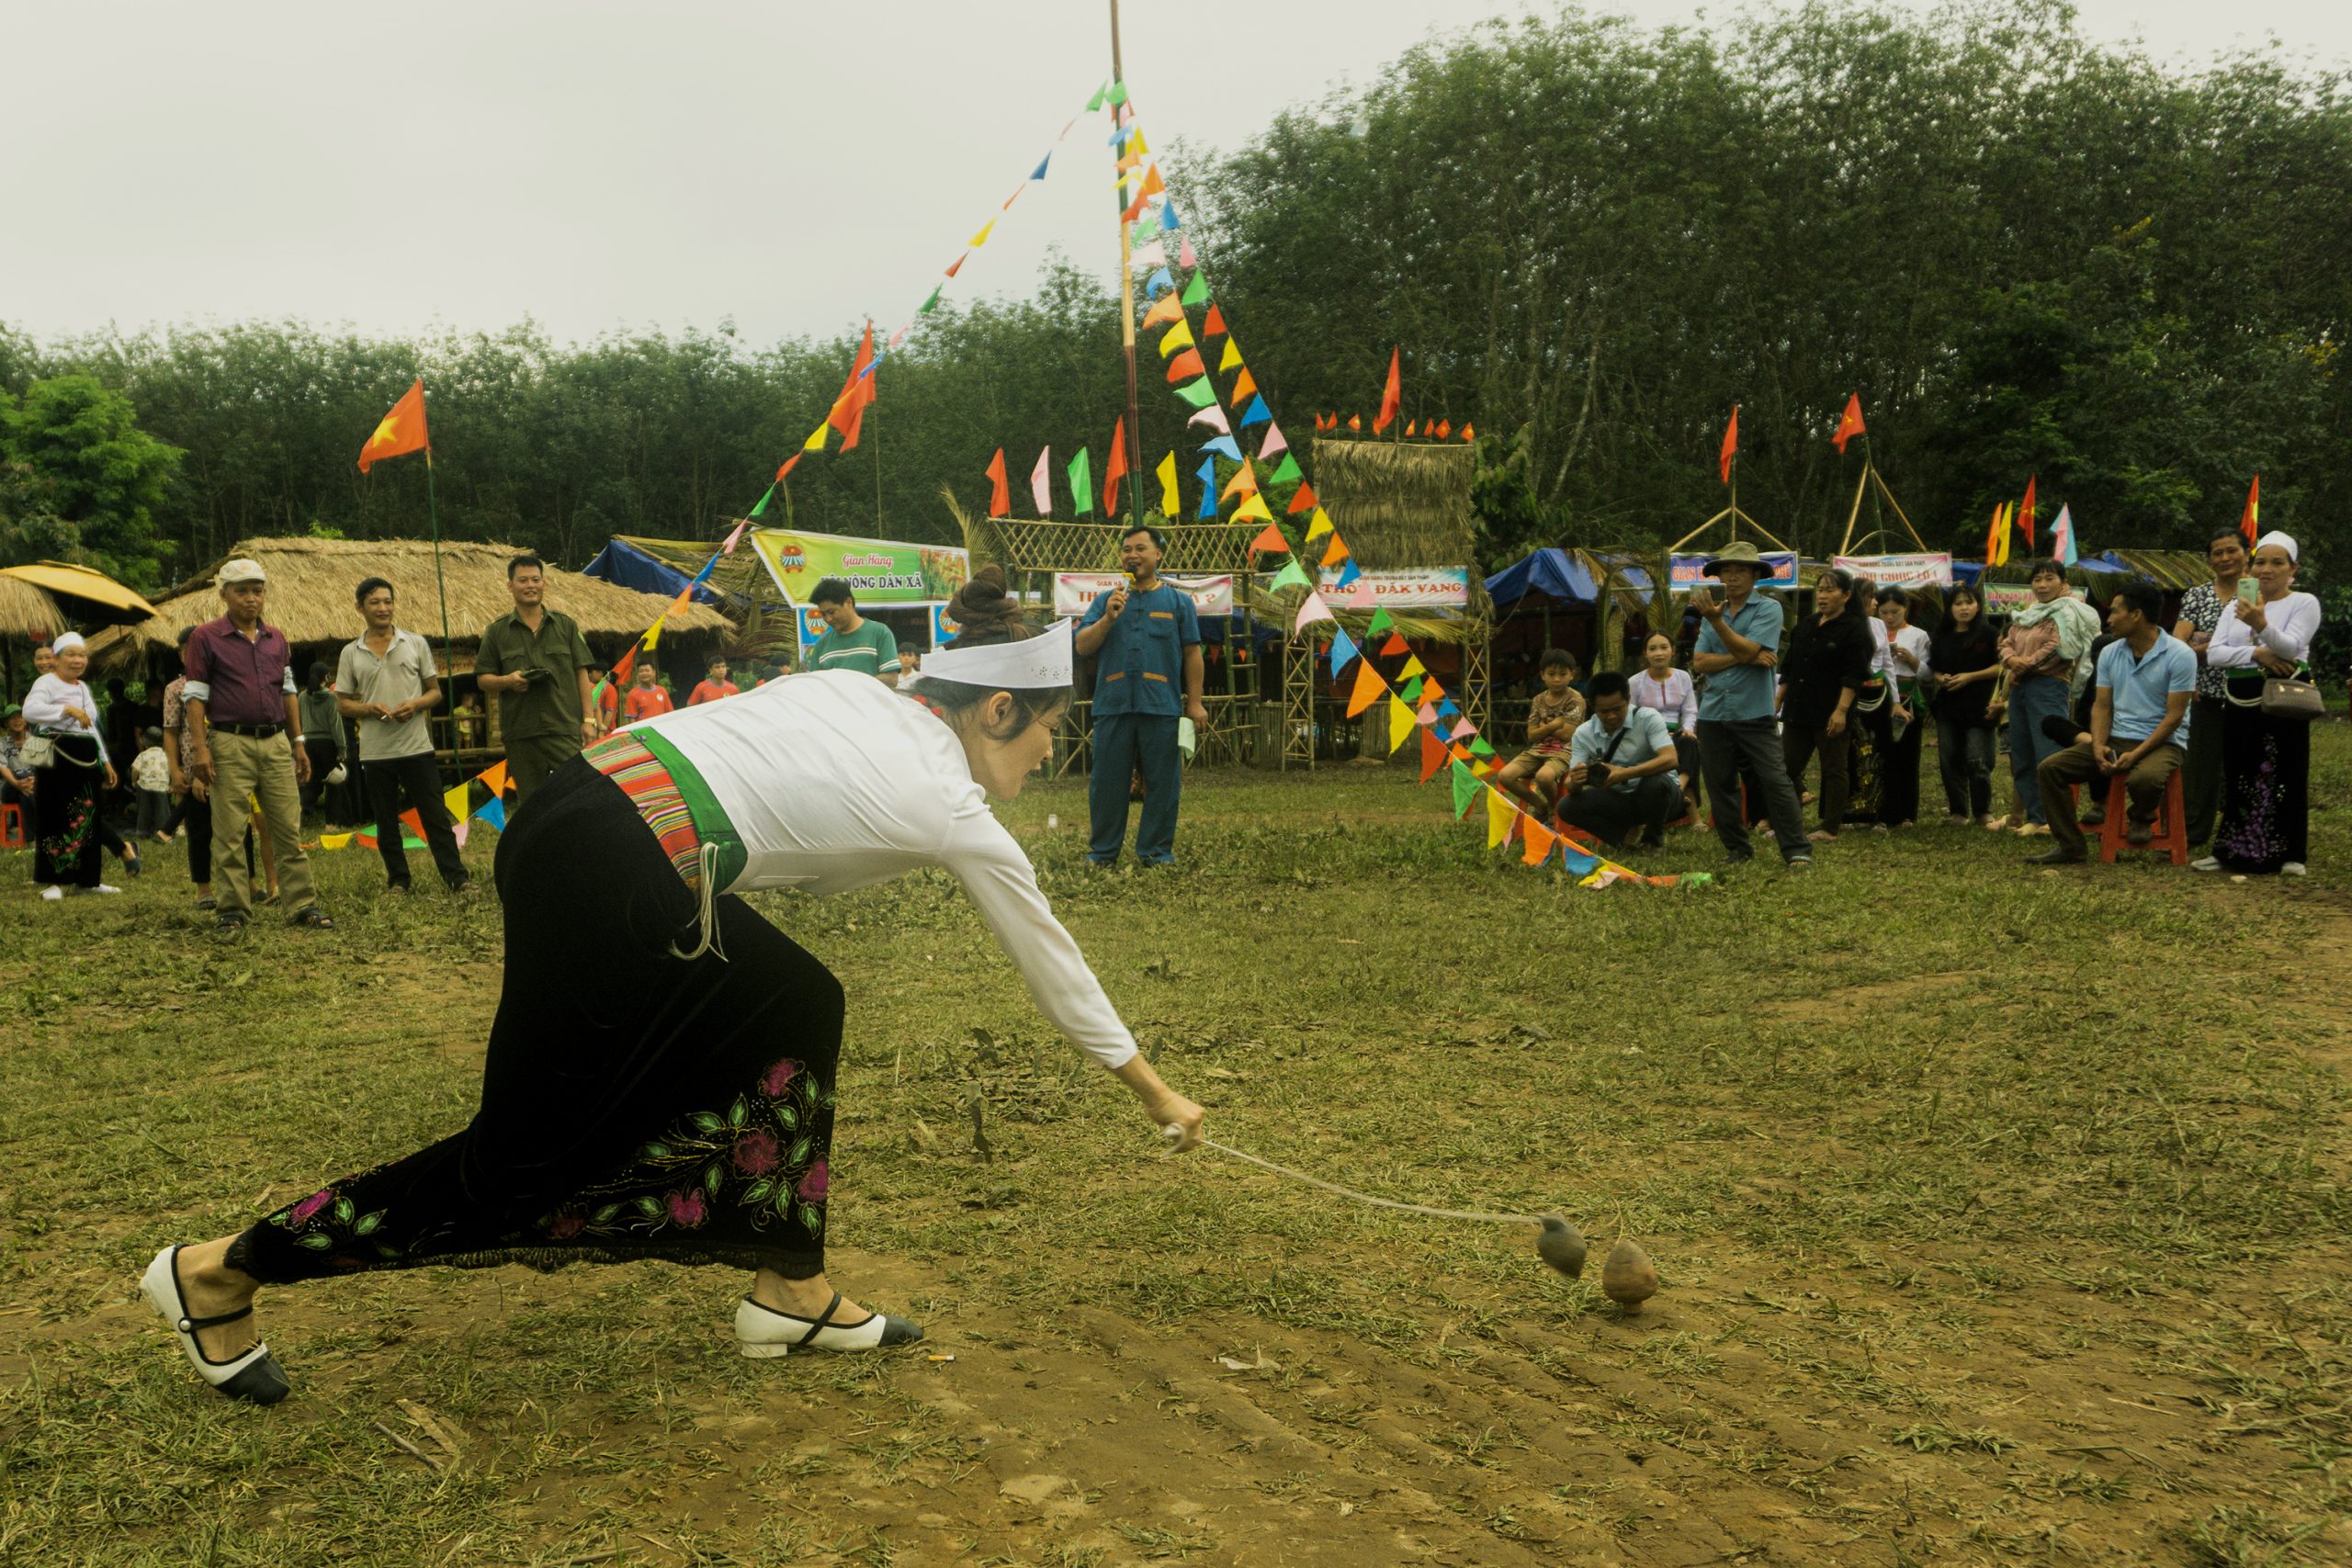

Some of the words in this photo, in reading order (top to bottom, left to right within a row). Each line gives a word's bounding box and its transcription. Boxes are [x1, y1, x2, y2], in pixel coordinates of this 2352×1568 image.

[842, 555, 865, 568] Gian
[878, 573, 903, 589] DÂN
[906, 572, 922, 588] XÃ
[1322, 581, 1364, 595] THÔ
[1374, 581, 1412, 594] ĐĂK
[1418, 582, 1463, 593] VANG
